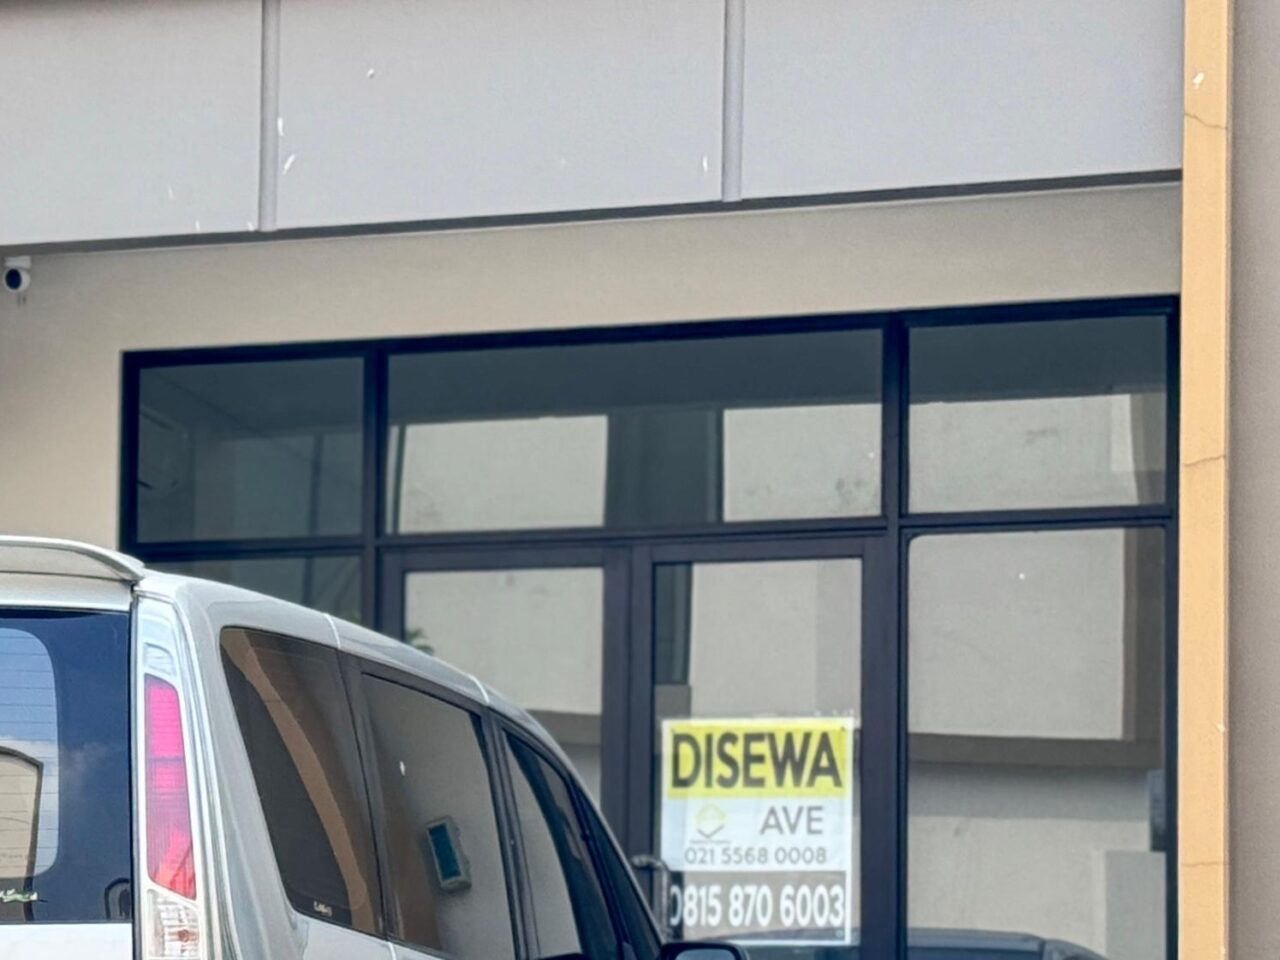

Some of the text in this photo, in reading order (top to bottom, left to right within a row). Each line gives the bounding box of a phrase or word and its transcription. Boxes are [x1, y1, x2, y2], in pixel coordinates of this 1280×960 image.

[671, 731, 843, 788] DISEWA
[760, 805, 823, 835] AVE
[684, 846, 827, 865] 021 5568 0008
[670, 884, 844, 927] 0815 870 6003
